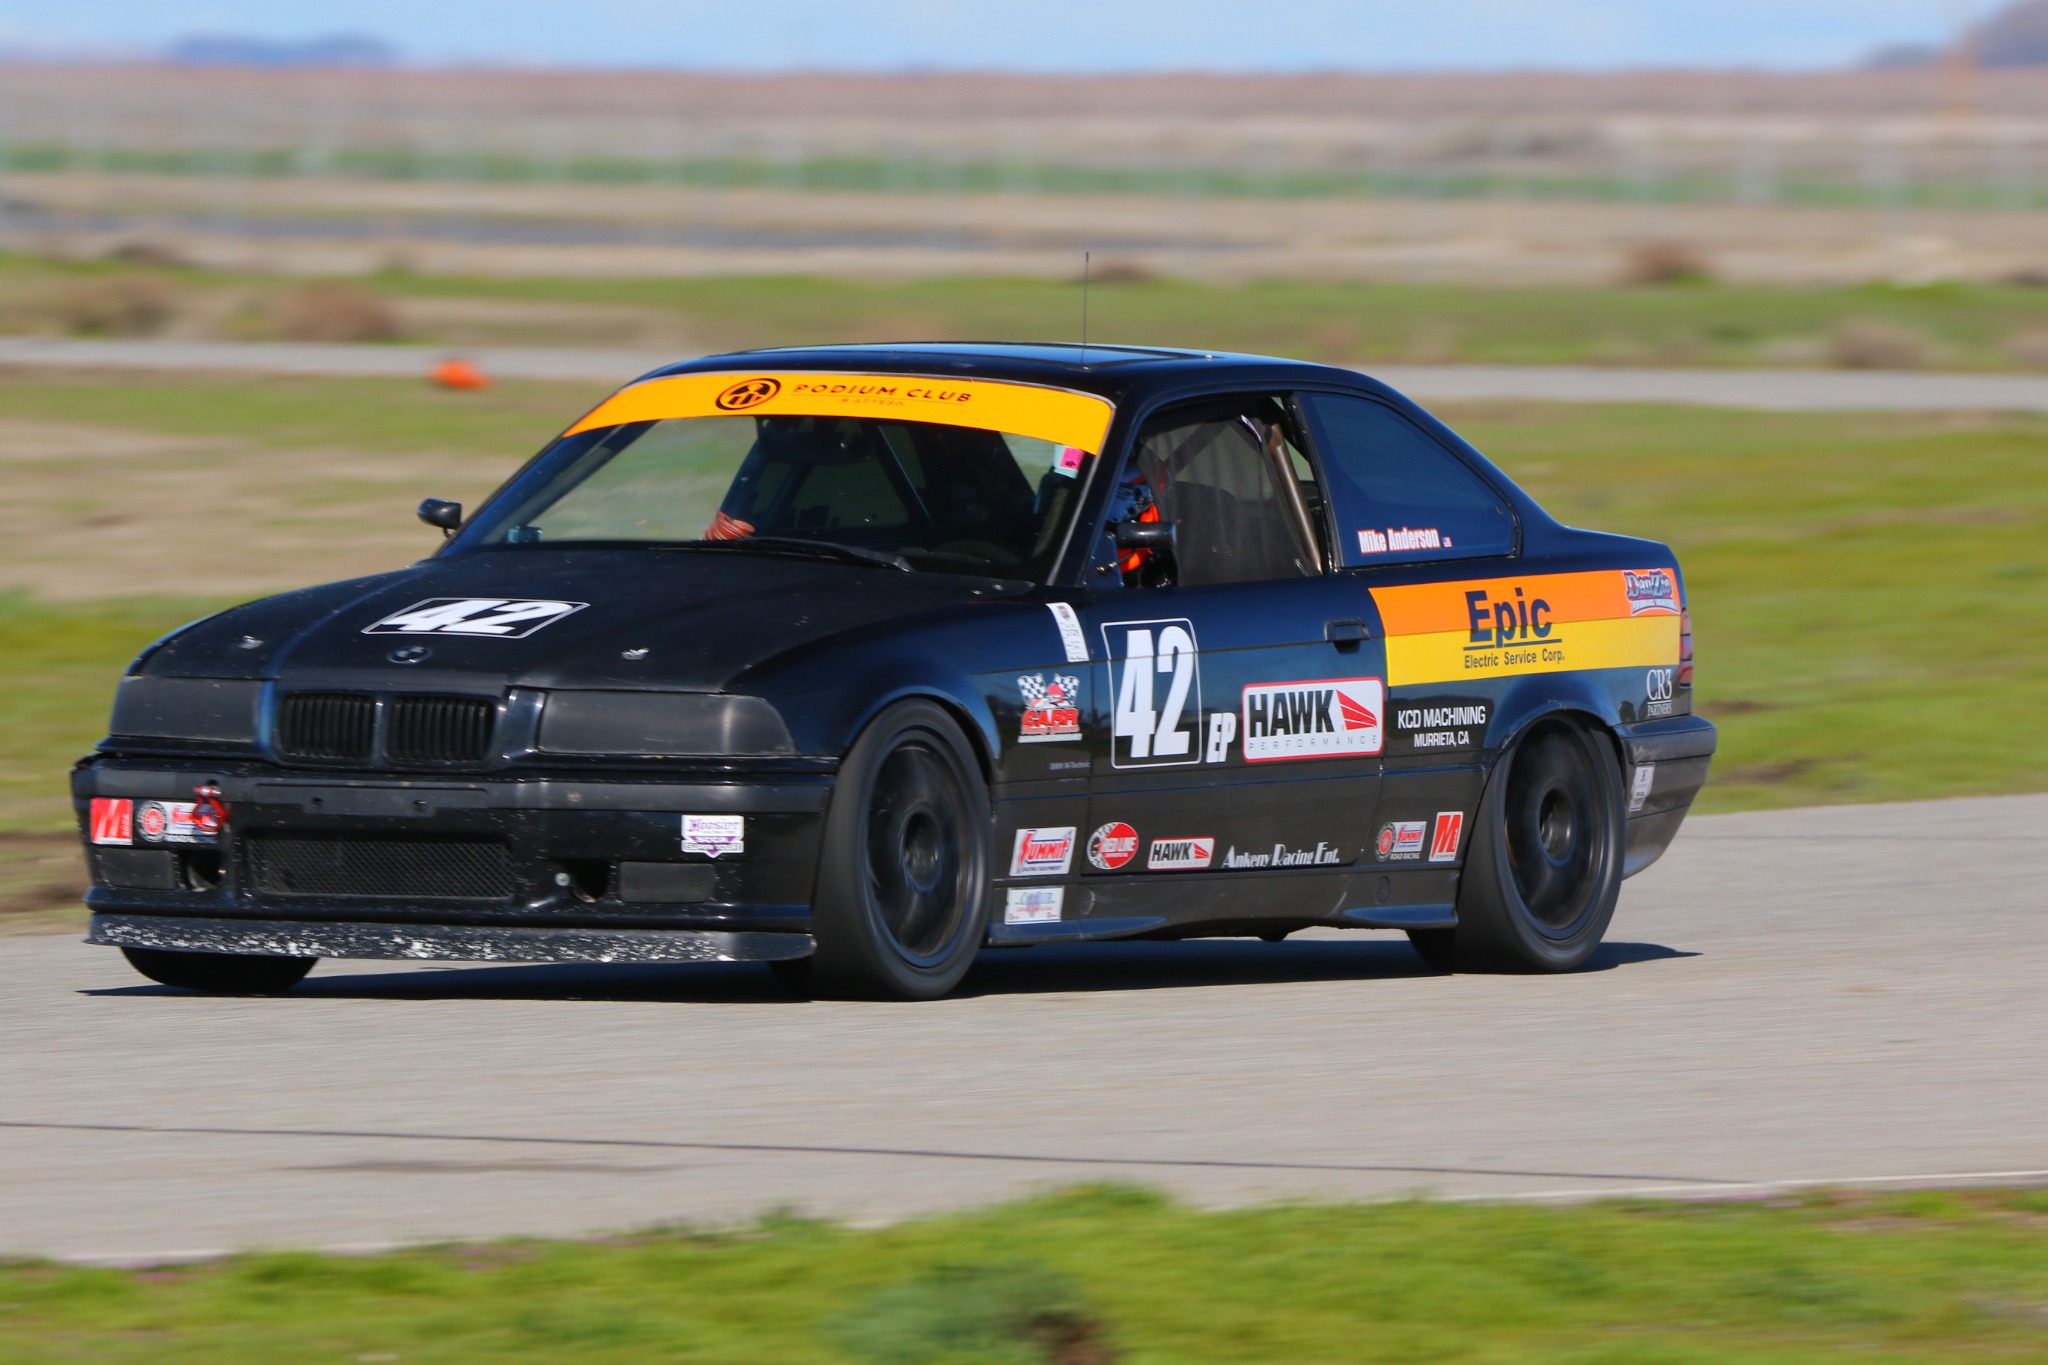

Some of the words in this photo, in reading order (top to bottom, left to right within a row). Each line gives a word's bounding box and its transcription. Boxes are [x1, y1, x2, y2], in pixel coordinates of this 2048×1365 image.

[793, 384, 898, 396] PODIUM
[906, 388, 972, 402] CLUB
[1357, 528, 1387, 554] Mike
[1387, 526, 1441, 551] Anderson
[381, 600, 573, 634] 42
[1464, 587, 1552, 648] Epic
[1464, 653, 1499, 669] Electric
[1504, 650, 1537, 665] Service
[1542, 648, 1565, 664] Corp.
[1115, 626, 1195, 758] 42
[1646, 669, 1673, 701] CR3
[1249, 689, 1336, 738] HAWK
[1397, 709, 1422, 729] KCD
[1423, 705, 1486, 728] MACHINING
[1206, 712, 1237, 763] EP
[1248, 735, 1378, 751] PERFORMANCE
[1413, 731, 1457, 748] MURRIETA,
[1457, 731, 1470, 745] CA
[1151, 842, 1194, 862] HAWK
[1221, 845, 1271, 868] Ankeny
[1271, 843, 1314, 866] Racing
[1314, 842, 1340, 864] Ent.
